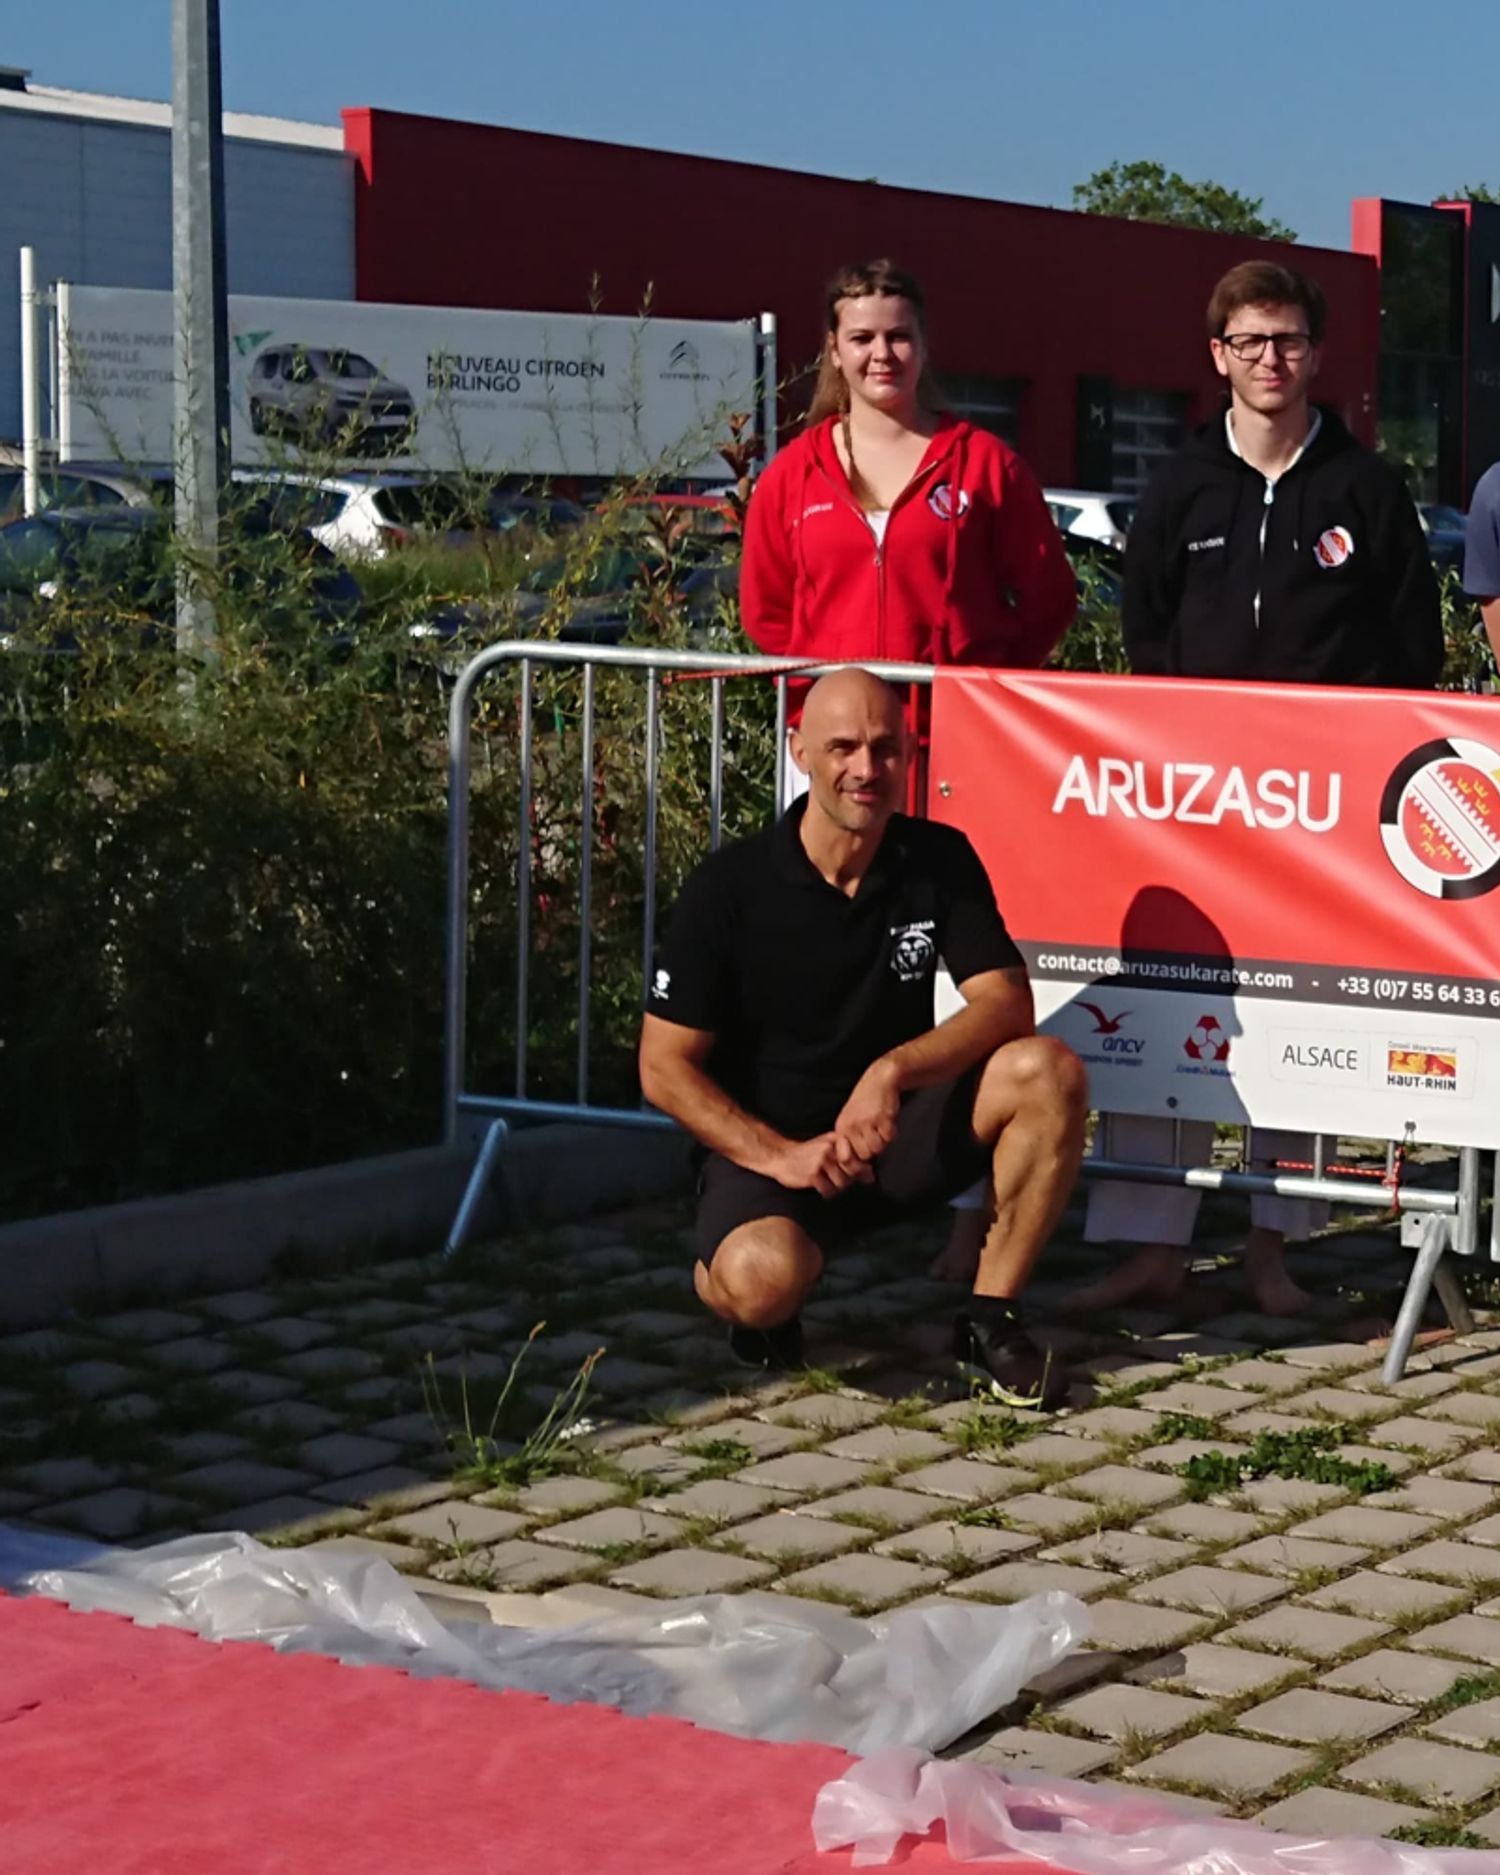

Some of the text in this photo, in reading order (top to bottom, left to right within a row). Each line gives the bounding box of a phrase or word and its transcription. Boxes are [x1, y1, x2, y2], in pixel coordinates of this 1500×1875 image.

[1052, 755, 1341, 832] ARUZASU
[1036, 951, 1294, 990] contact@aruzasukarate.com
[1337, 976, 1370, 996] +33
[1373, 976, 1407, 1001] (0)7
[1411, 981, 1434, 1001] 55
[1438, 983, 1461, 1003] 64
[1463, 985, 1486, 1006] 33
[1102, 1037, 1146, 1054] ancv
[1282, 1044, 1358, 1070] ALSACE
